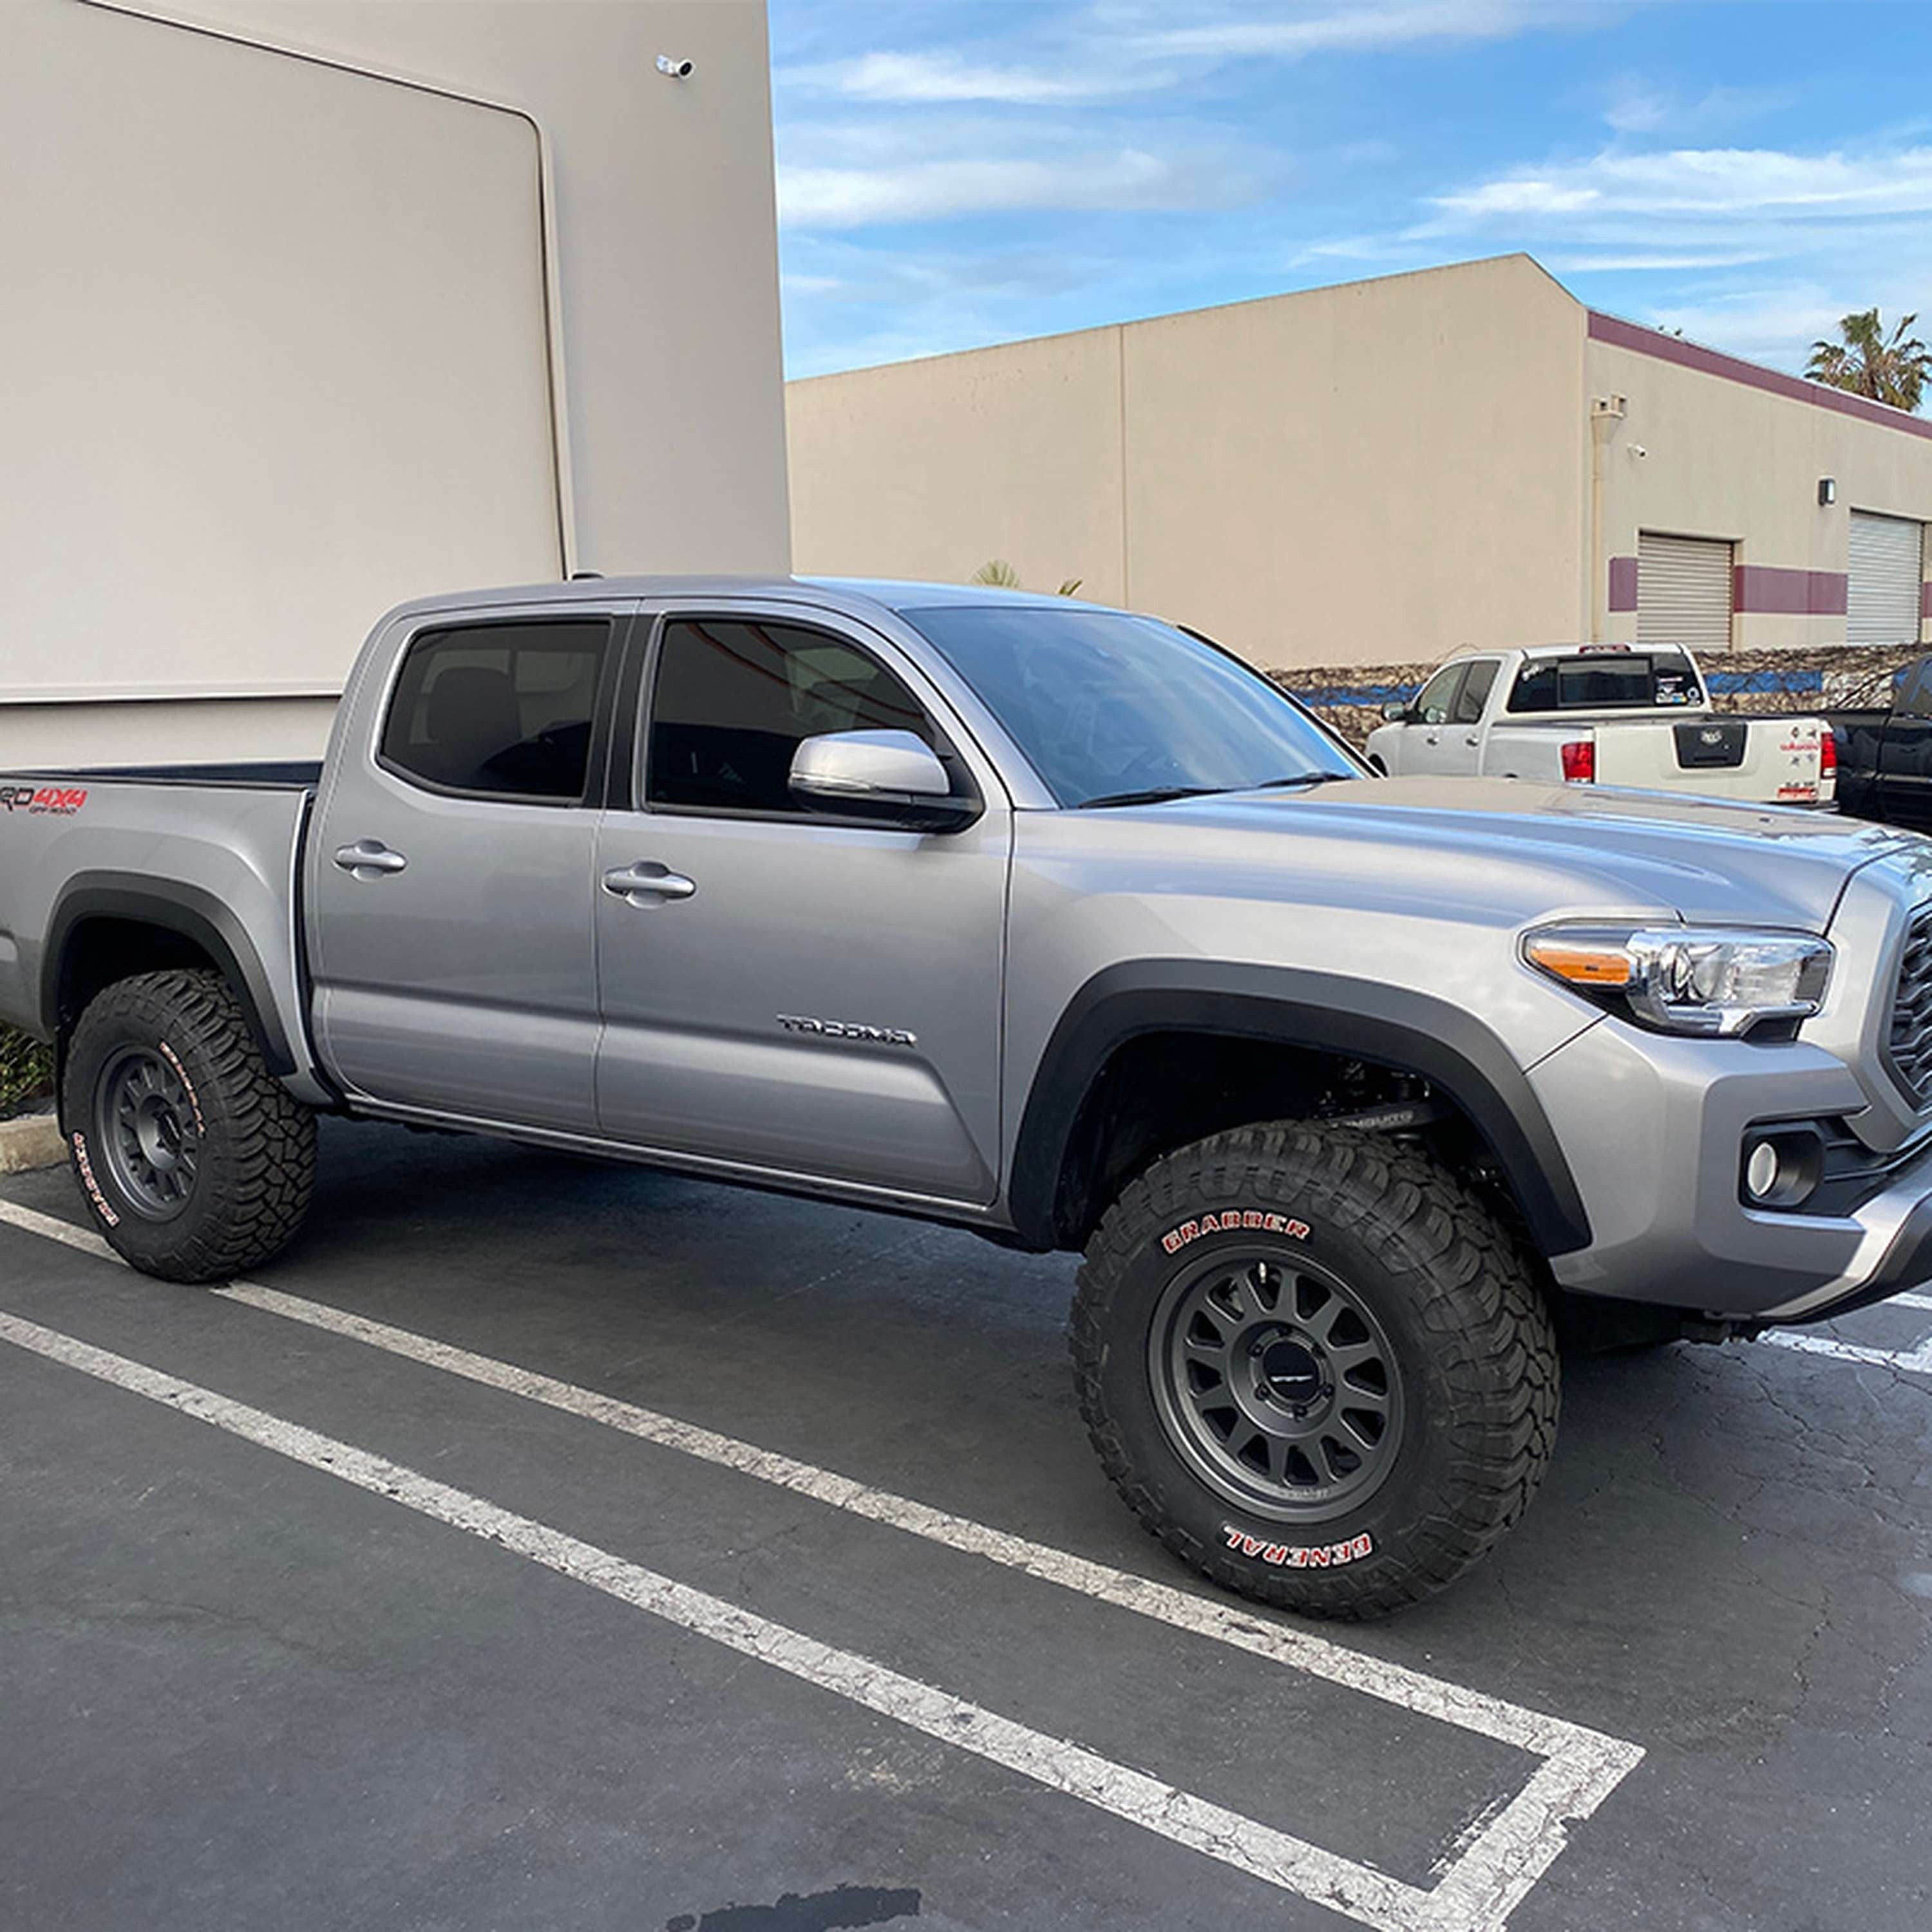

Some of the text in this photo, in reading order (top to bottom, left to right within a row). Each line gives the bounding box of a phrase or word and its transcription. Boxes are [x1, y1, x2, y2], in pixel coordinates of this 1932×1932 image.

[776, 1013, 918, 1048] TACOMA
[1161, 1210, 1311, 1254] GRABBER
[1223, 1524, 1373, 1567] GENERAL
